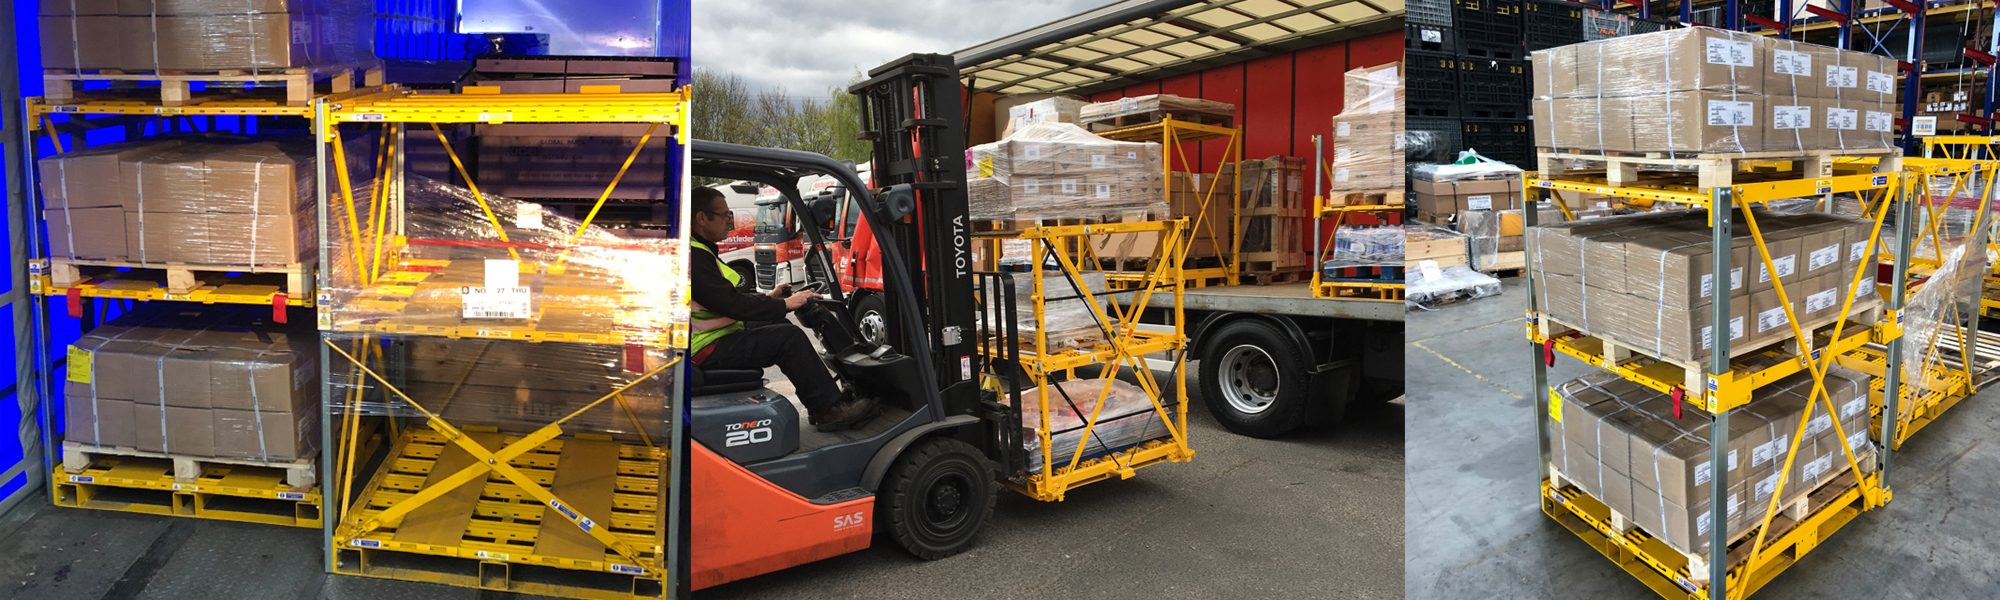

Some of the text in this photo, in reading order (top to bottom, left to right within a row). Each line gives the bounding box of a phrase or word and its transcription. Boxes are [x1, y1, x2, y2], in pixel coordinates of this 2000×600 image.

[952, 214, 966, 279] TOYOTA
[725, 427, 772, 448] 20
[833, 511, 864, 529] SAS
